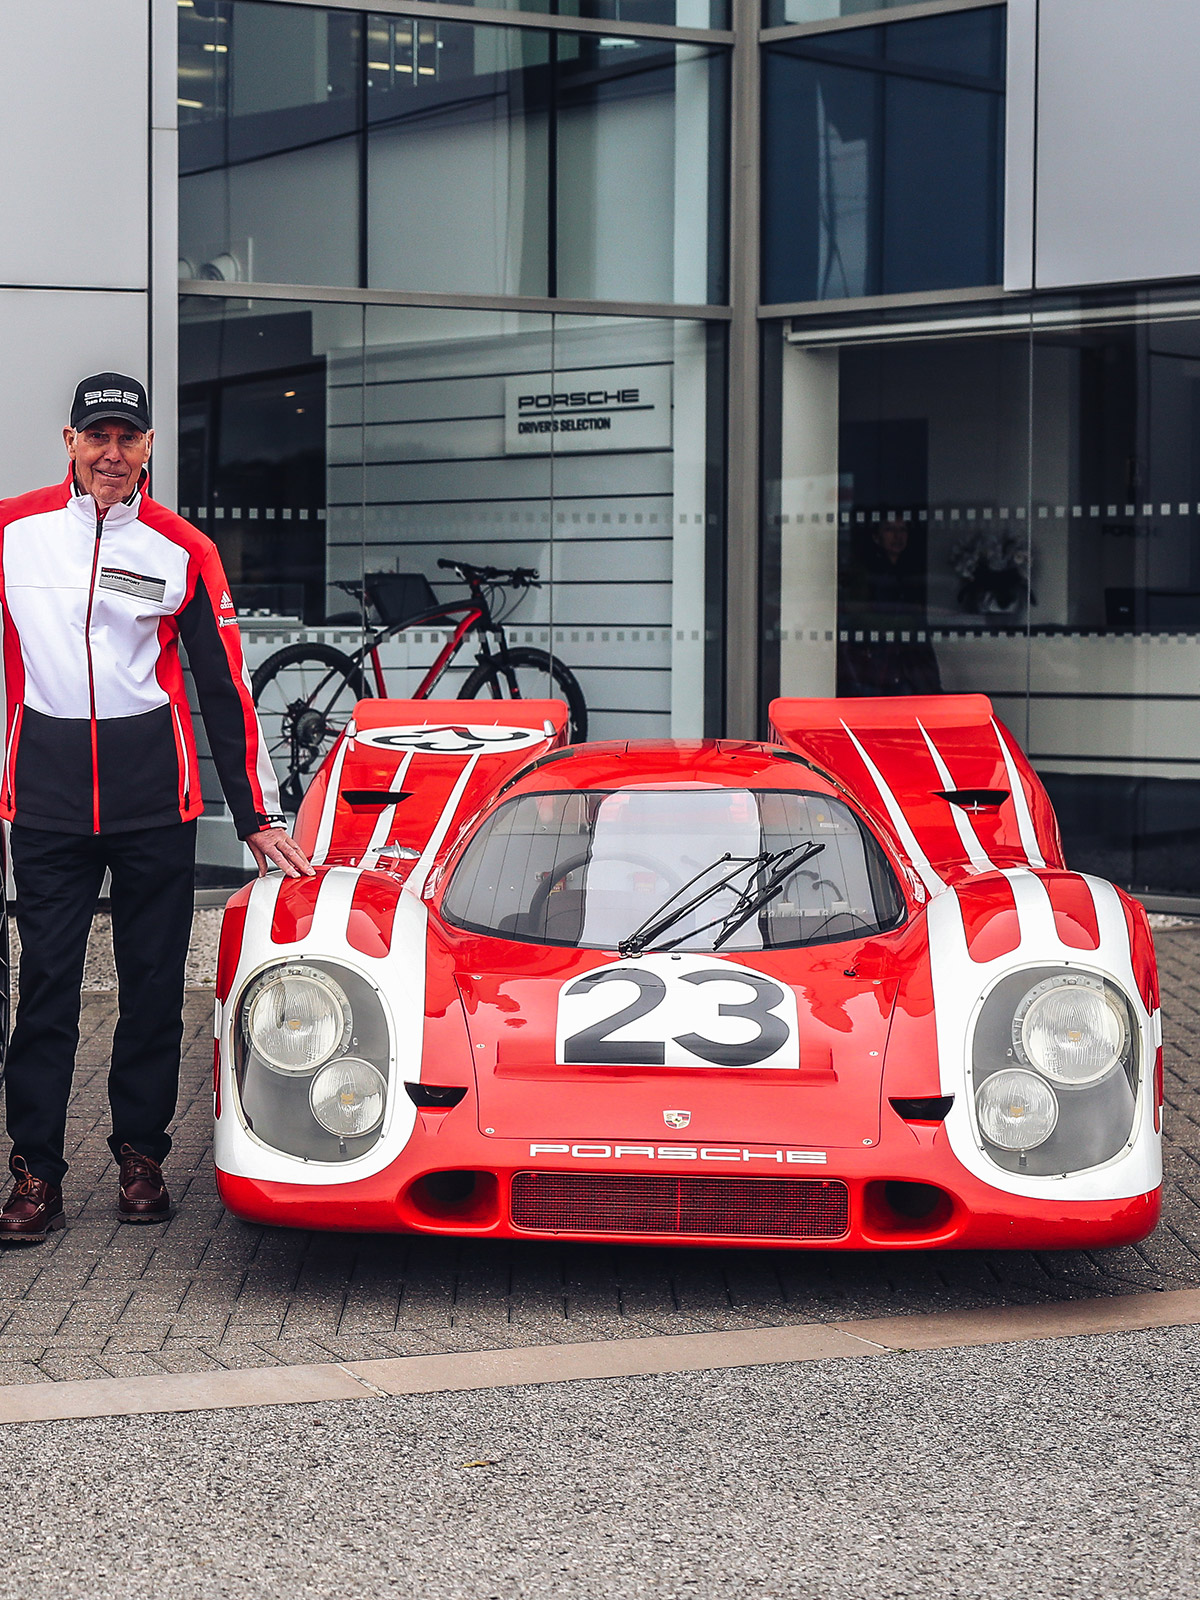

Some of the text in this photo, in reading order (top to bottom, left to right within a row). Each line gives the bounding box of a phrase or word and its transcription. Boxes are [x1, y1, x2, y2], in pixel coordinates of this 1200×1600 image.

[518, 389, 639, 409] PORSCHE
[560, 417, 611, 432] SELECTION
[101, 574, 140, 585] MOTORSPORT
[564, 967, 790, 1067] 23
[529, 1143, 828, 1165] PORSCHE
